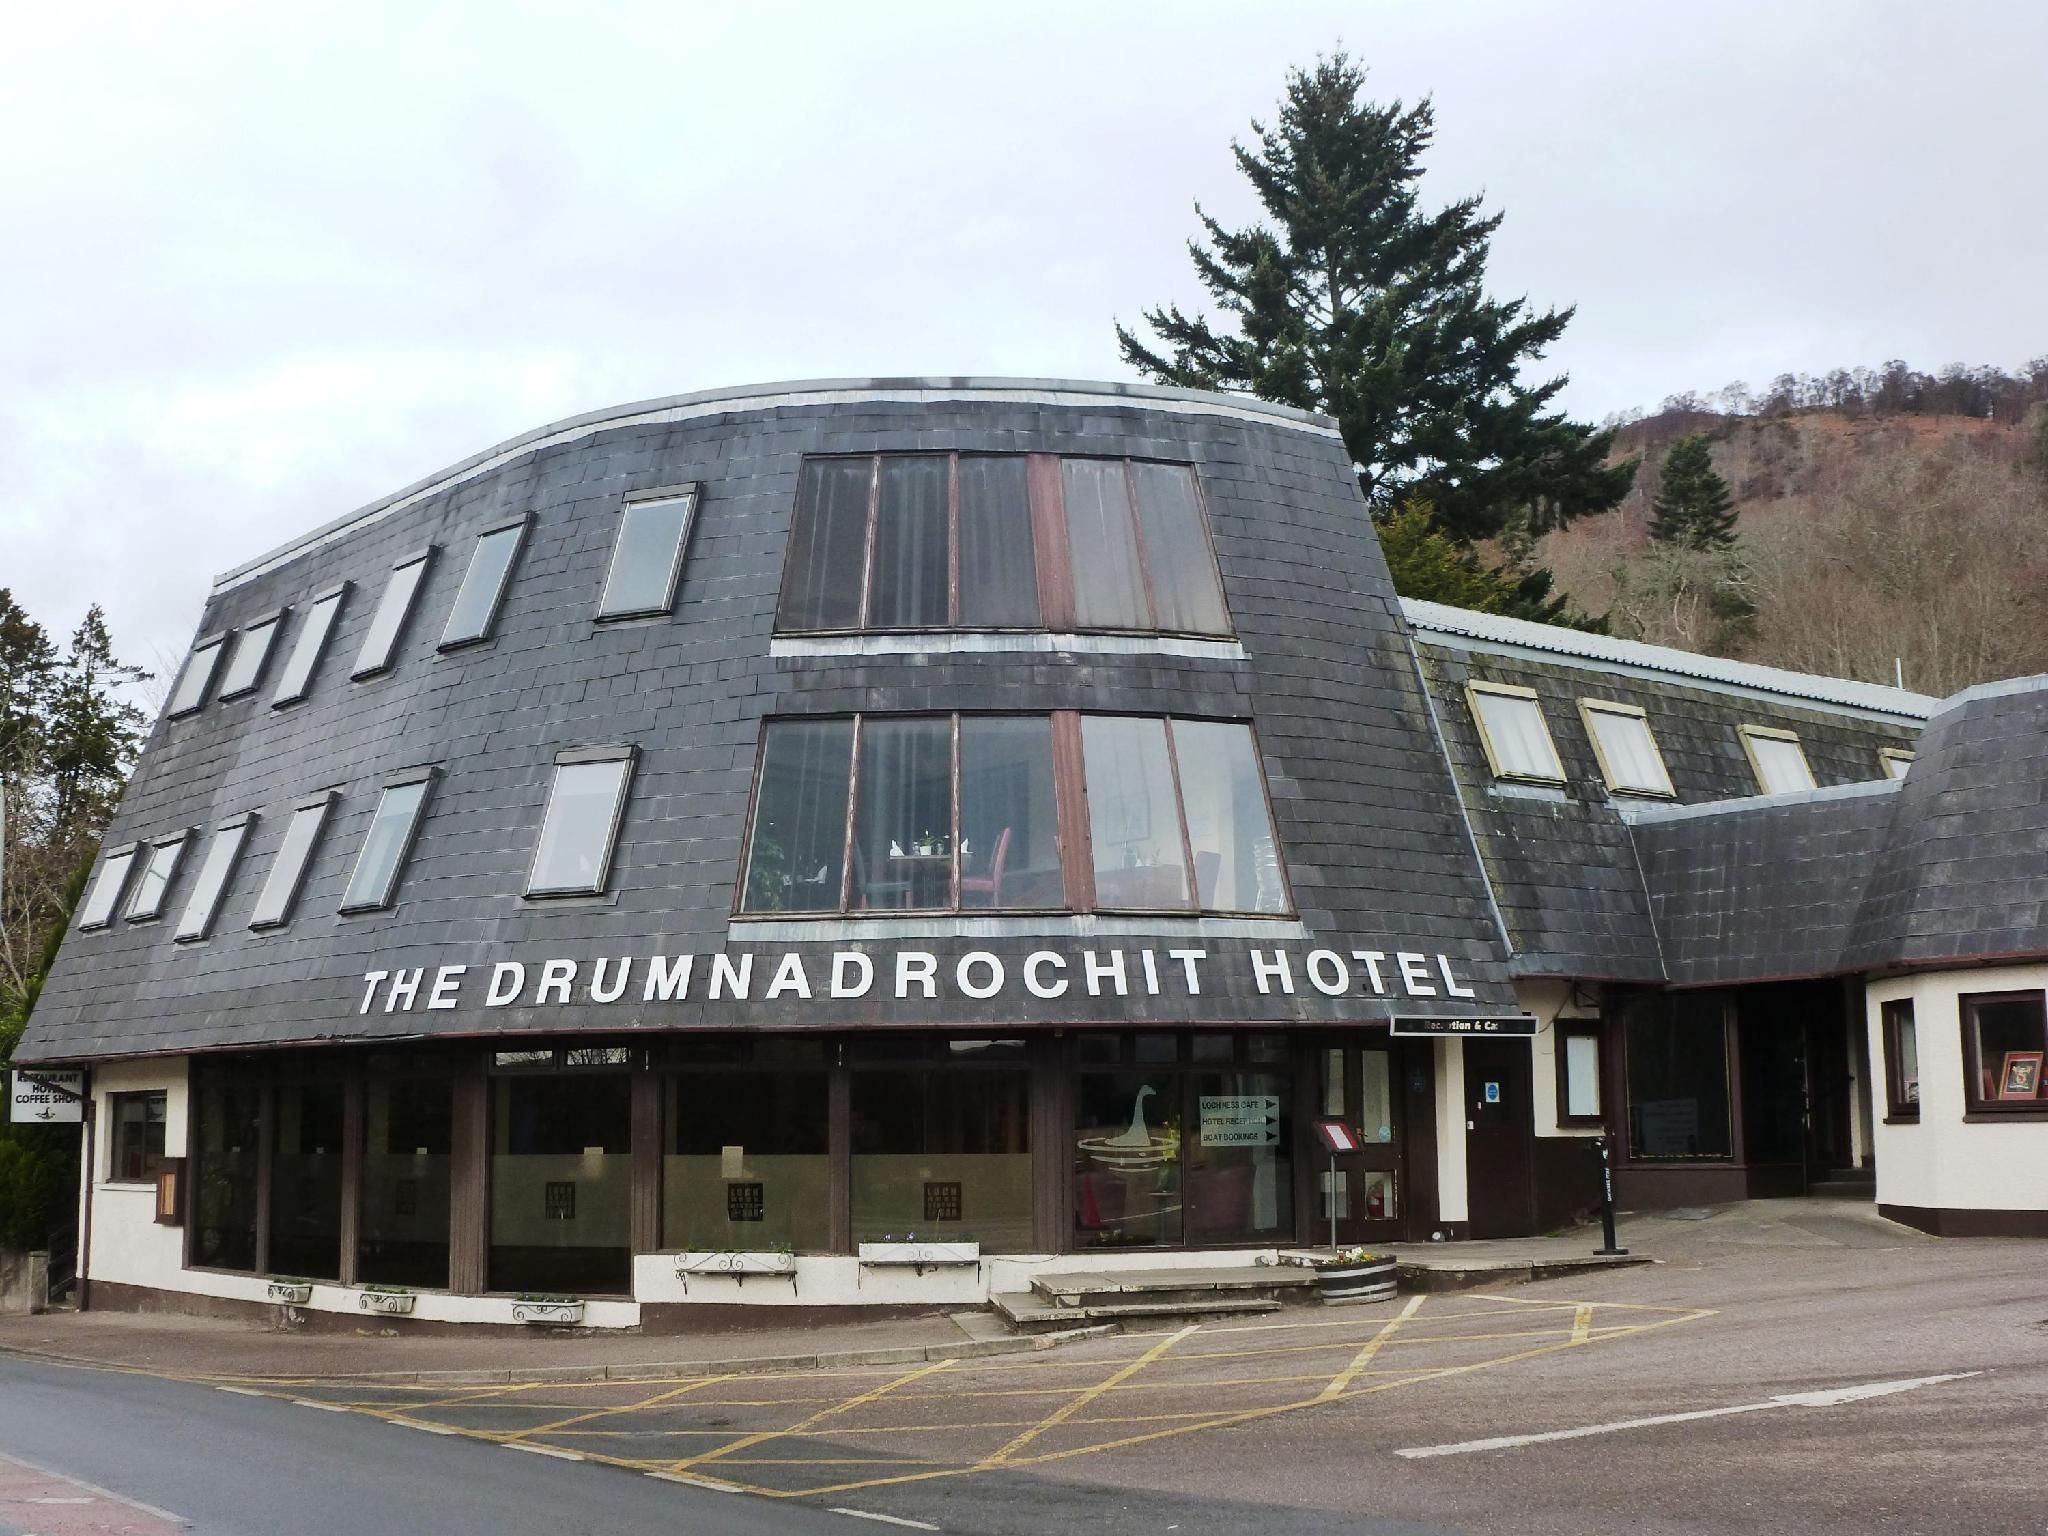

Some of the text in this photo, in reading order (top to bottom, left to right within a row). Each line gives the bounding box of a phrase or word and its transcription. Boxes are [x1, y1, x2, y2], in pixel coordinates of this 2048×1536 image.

[359, 949, 1476, 1015] THE DRUMNADROCHIT HOTEL
[1474, 1021, 1481, 1030] &
[15, 1094, 50, 1104] COFFEE
[1202, 1101, 1221, 1109] LOCH
[1222, 1101, 1239, 1109] NESS
[1202, 1117, 1224, 1125] HOTEL
